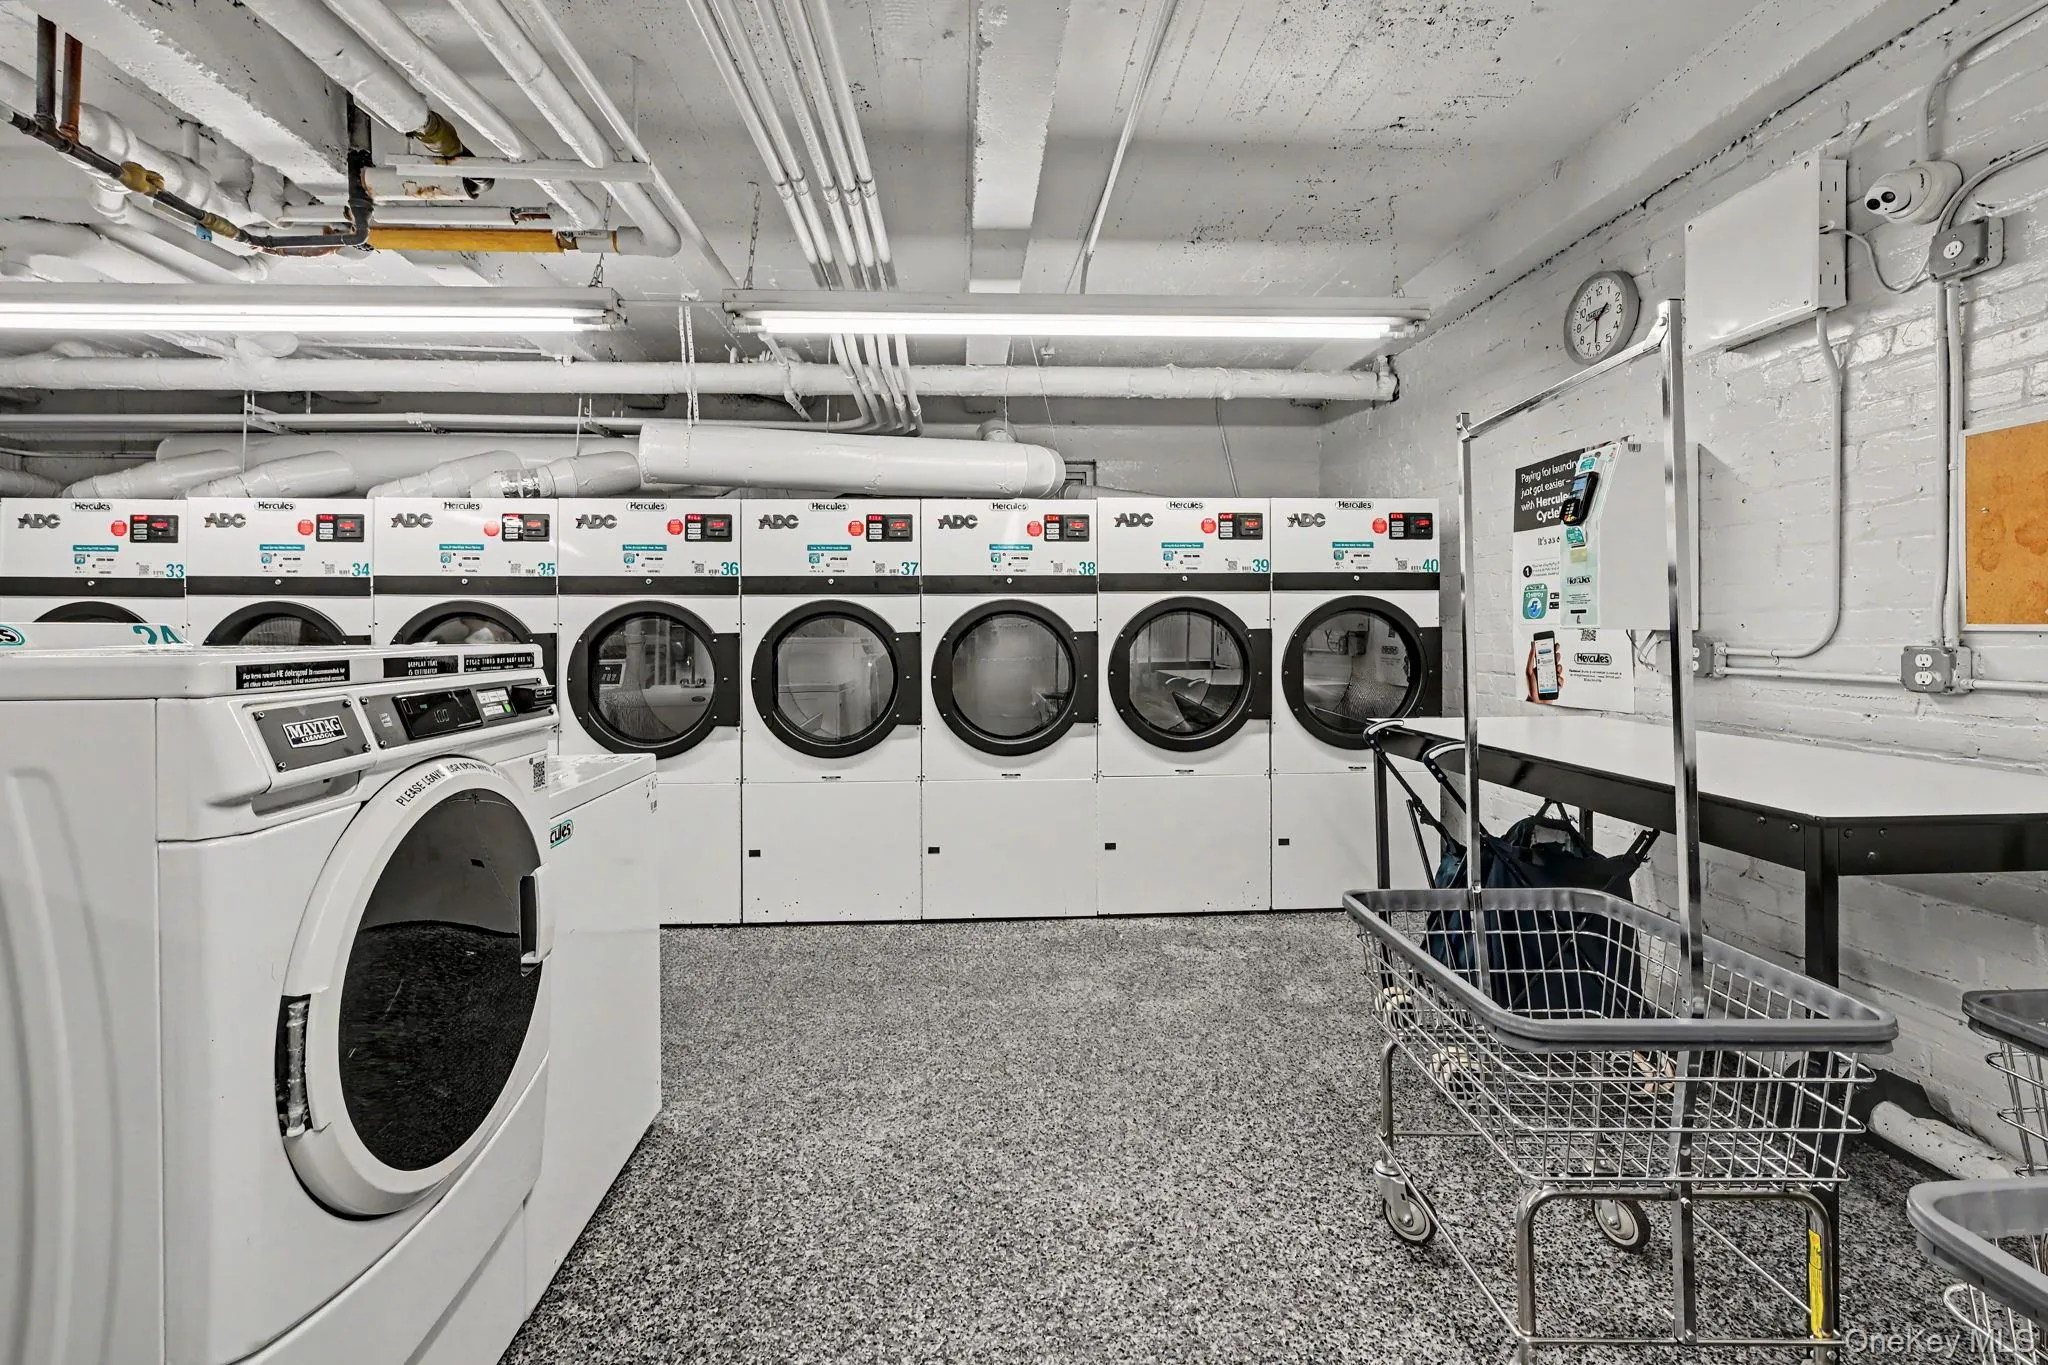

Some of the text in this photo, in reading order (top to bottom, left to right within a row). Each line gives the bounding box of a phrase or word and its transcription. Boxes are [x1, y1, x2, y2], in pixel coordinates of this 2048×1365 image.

[1595, 286, 1603, 296] 12
[1606, 285, 1610, 294] 1
[1615, 292, 1620, 301] 2
[1580, 308, 1587, 319] 10
[1617, 304, 1622, 314] 3
[1576, 324, 1581, 333] 9
[1613, 321, 1619, 329] 4
[1580, 335, 1585, 346] 8
[1605, 333, 1612, 343] 5
[1587, 342, 1591, 352] 7
[1595, 342, 1601, 351] 6
[1521, 471, 1541, 483] Paying
[1542, 467, 1551, 477] for
[1533, 484, 1544, 496] got
[258, 501, 294, 510] Hercules
[444, 501, 480, 510] Hercules
[630, 501, 665, 510] Hercules
[812, 502, 847, 510] Hercules
[1169, 501, 1204, 509] Hercules
[1338, 500, 1372, 509] Hercules
[1521, 492, 1570, 511] with Hercule
[17, 513, 61, 529] ADC
[204, 512, 247, 529] ADC
[391, 513, 433, 528] ADC
[575, 514, 618, 529] ADC
[758, 514, 800, 529] ADC
[937, 514, 978, 529] ADC
[1114, 512, 1154, 528] ADC
[1287, 513, 1326, 528] ADC
[166, 564, 184, 578] 33
[351, 563, 370, 577] 34
[538, 562, 556, 576] 35
[721, 561, 739, 576] 36
[901, 561, 919, 576] 37
[1078, 561, 1096, 575] 38
[1252, 559, 1270, 572] 39
[1422, 559, 1439, 572] 40
[1577, 653, 1610, 664] Hercules
[286, 718, 342, 739] MAYTAG
[395, 781, 426, 807] PLEASE
[421, 769, 446, 786] LEAVE
